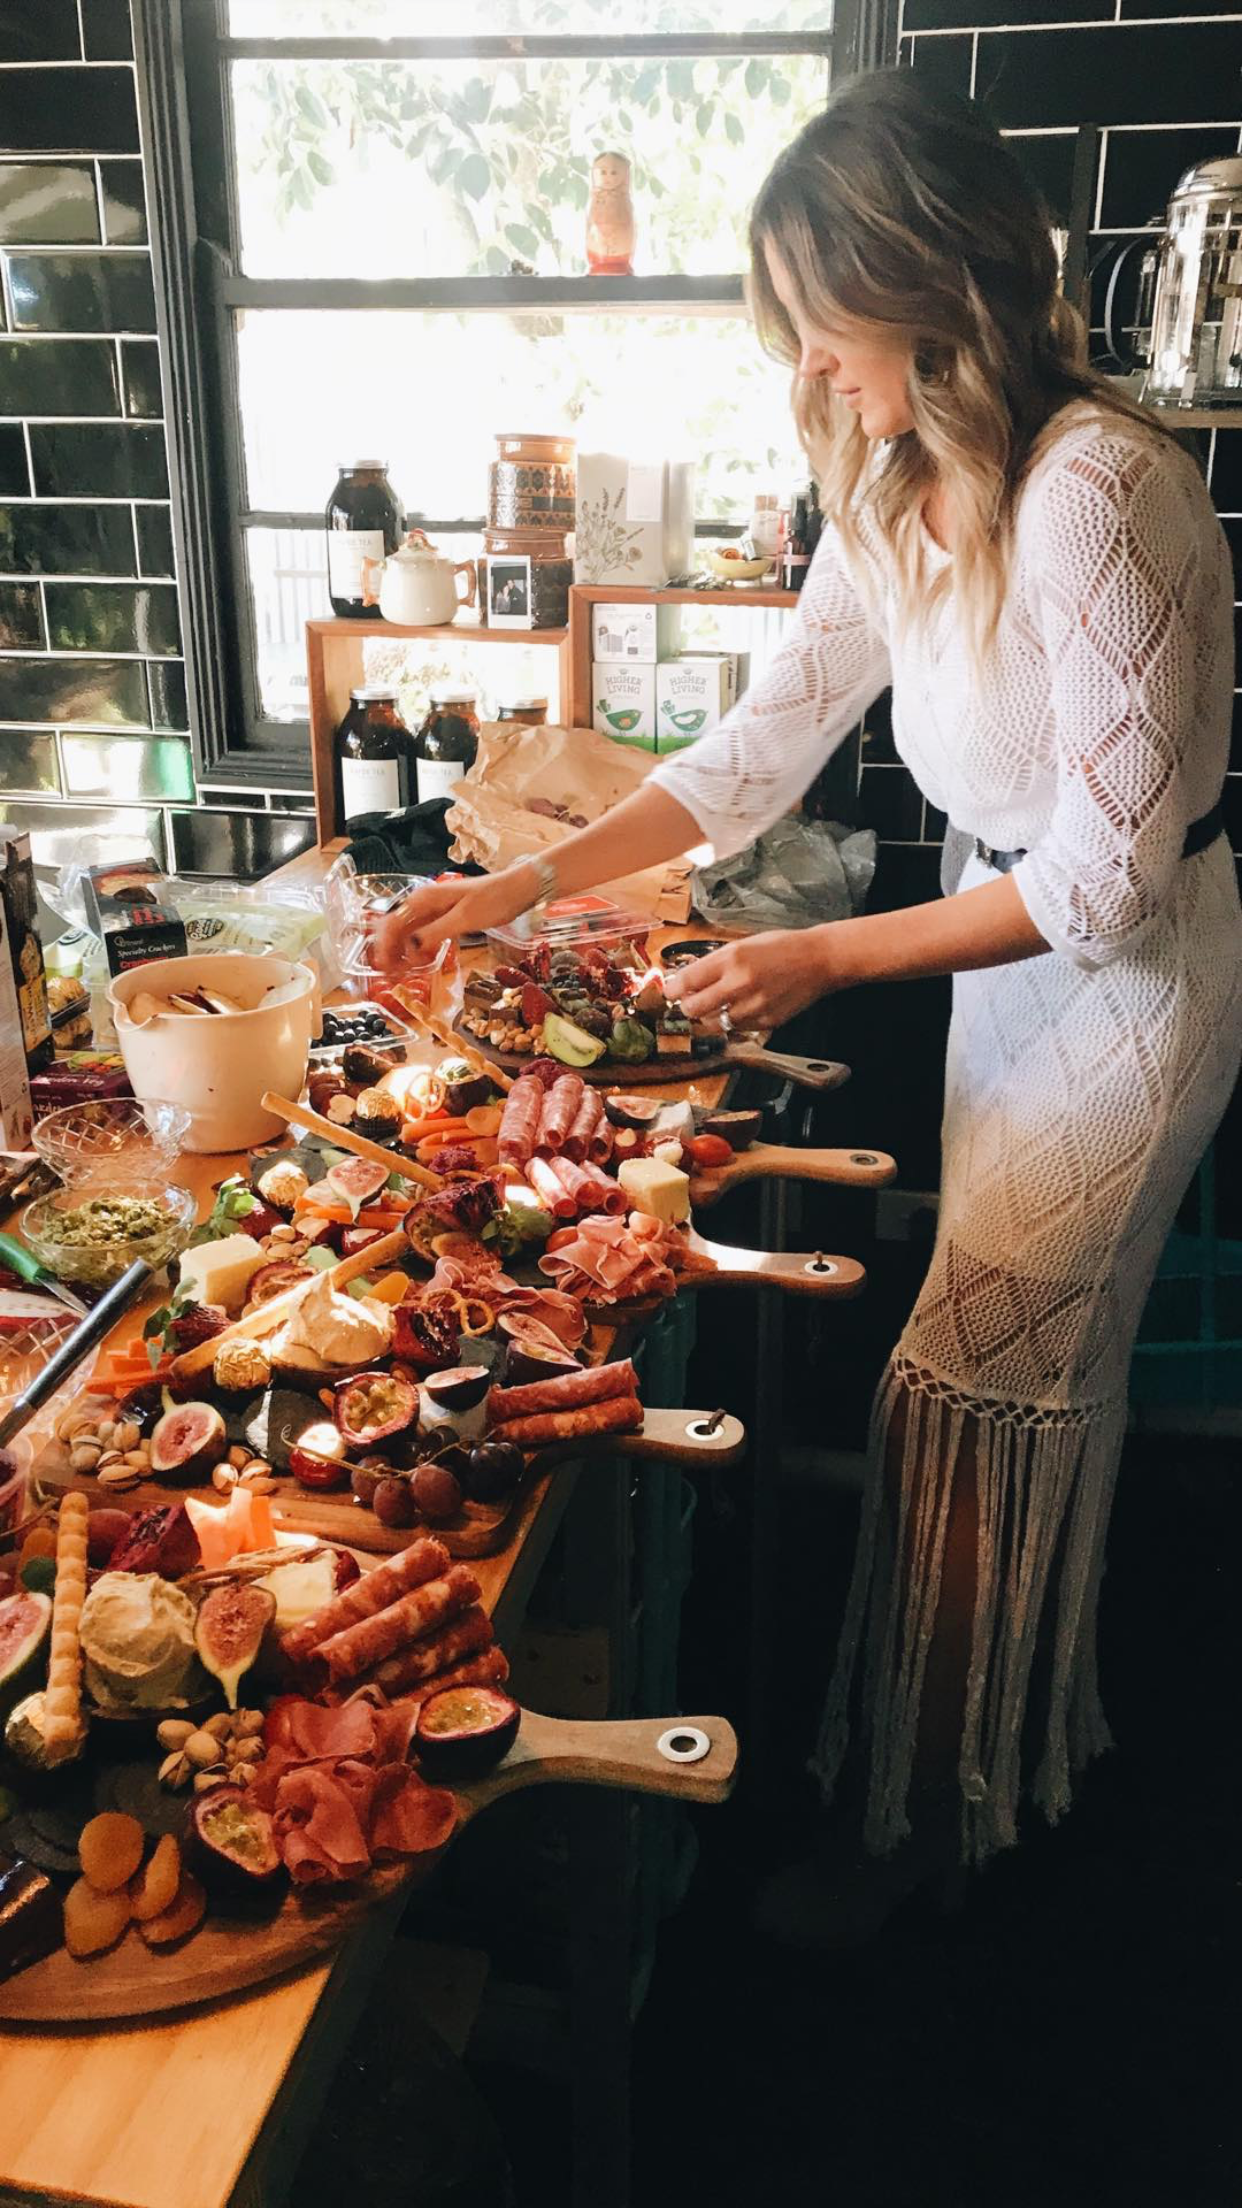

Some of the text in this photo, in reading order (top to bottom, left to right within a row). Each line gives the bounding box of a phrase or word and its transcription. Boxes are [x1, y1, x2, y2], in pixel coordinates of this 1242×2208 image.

[605, 675, 644, 686] HIGHER
[669, 675, 708, 686] HIGHER
[607, 684, 641, 695] LIVING
[671, 684, 706, 695] LIVING
[117, 943, 176, 959] Specialty Crackers
